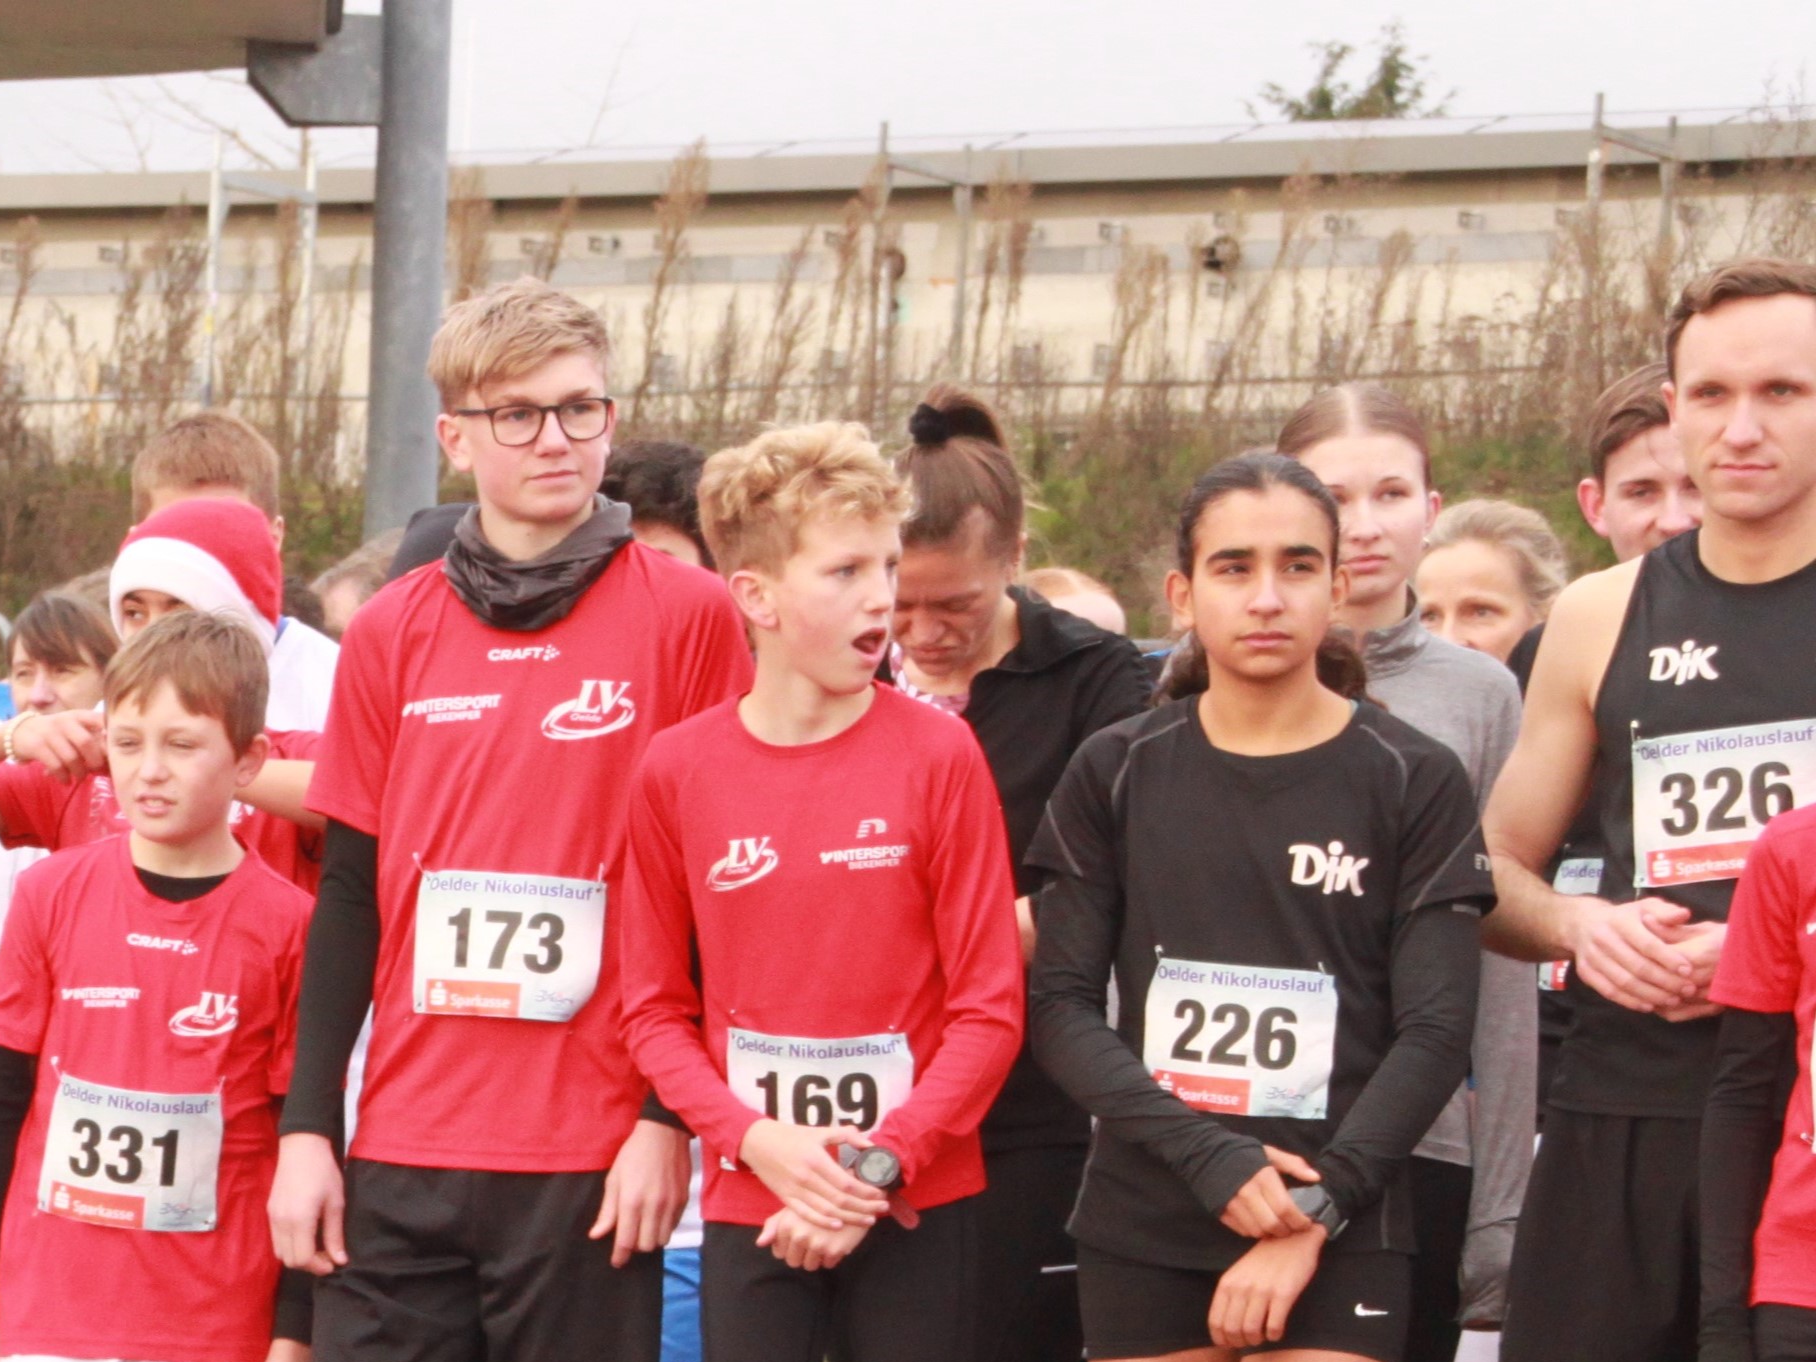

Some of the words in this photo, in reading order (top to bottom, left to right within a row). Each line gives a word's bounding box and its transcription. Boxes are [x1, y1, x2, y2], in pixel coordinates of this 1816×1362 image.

[487, 646, 544, 662] CRAFT
[407, 693, 502, 716] INTERSPORT
[574, 679, 632, 715] LV
[1640, 743, 1690, 761] Oelder
[1695, 726, 1815, 754] Nikolauslauf
[1659, 760, 1795, 838] 326
[726, 835, 772, 869] LV
[825, 844, 912, 864] INTERSPOR
[429, 876, 479, 893] Oelder
[484, 878, 593, 901] Nikolauslauf
[126, 933, 183, 952] CRAFT
[447, 907, 565, 974] 173
[64, 986, 141, 1000] INTERSPORT
[1157, 965, 1207, 983] Oelder
[1210, 970, 1325, 993] Nikolauslauf
[194, 991, 239, 1021] LV
[450, 992, 512, 1010] Sparkasse
[736, 1035, 784, 1056] Oelder
[787, 1039, 897, 1060] Nikolauslauf
[1170, 998, 1298, 1070] 226
[62, 1082, 102, 1105] Oelder
[107, 1094, 209, 1115] Nikolauslauf
[755, 1070, 879, 1133] 169
[1176, 1086, 1240, 1106] Sparkasse
[68, 1117, 180, 1187] 331
[72, 1200, 135, 1222] Sparkasse
